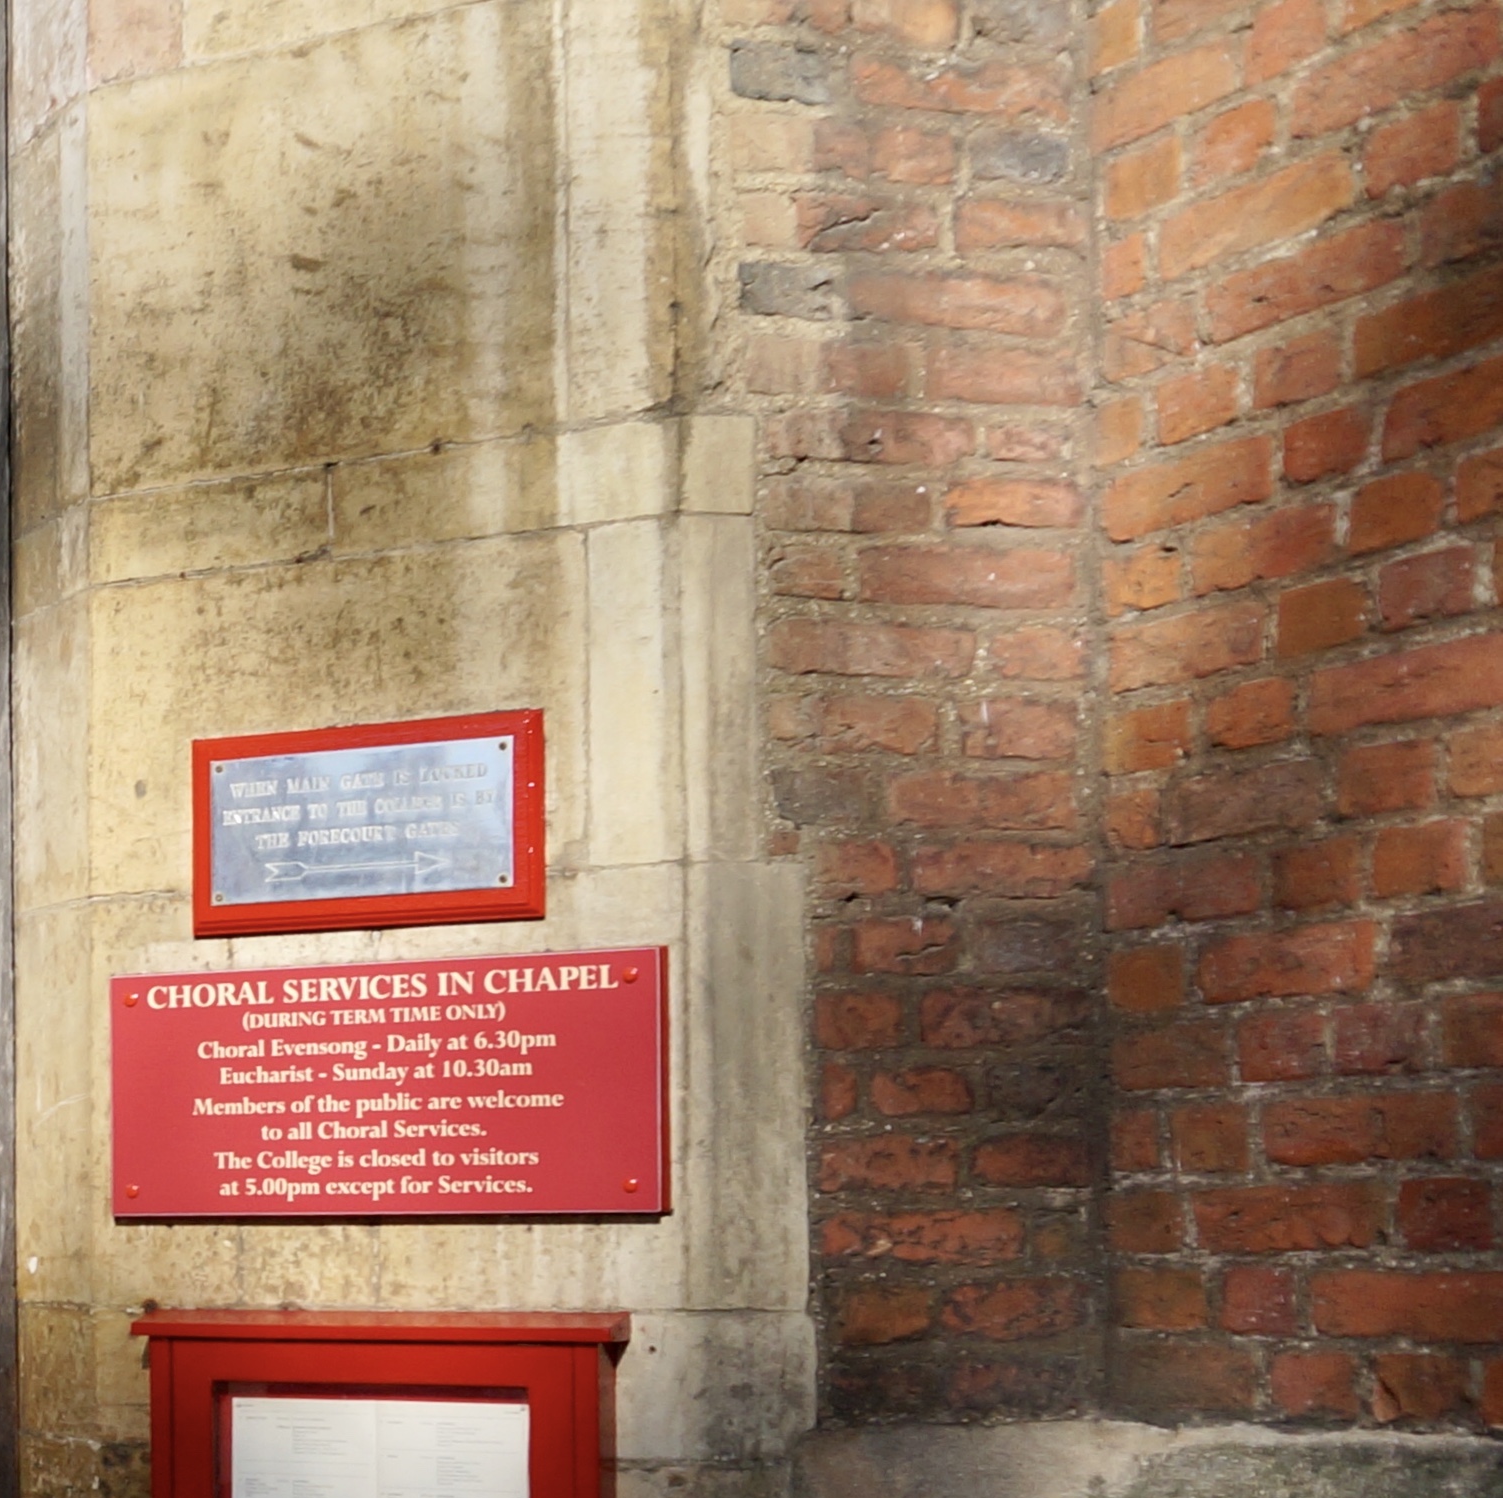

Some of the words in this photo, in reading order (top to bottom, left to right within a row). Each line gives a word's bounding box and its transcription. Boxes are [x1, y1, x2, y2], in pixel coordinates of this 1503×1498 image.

[230, 780, 278, 799] WHEN
[287, 776, 330, 794] MAIN
[340, 772, 384, 789] GATE
[394, 769, 411, 785] IS
[420, 763, 488, 783] LOCKED
[223, 805, 300, 826] ENTRANCE
[308, 803, 328, 819] TO
[337, 800, 366, 817] THE
[374, 794, 442, 815] COLLEGE
[450, 792, 466, 808] IS
[475, 789, 496, 806] BY
[255, 832, 289, 850] THE
[298, 825, 396, 846] FORECOURT
[405, 821, 460, 839] GATES
[147, 981, 274, 1009] CHORAL
[283, 973, 427, 1003] SERVICES
[438, 971, 474, 996] IN
[484, 965, 618, 994] CHAPEL
[242, 1011, 326, 1031] (DURING
[330, 1008, 386, 1025] TERM
[390, 1006, 441, 1022] TIME
[446, 1001, 505, 1021] ONLY)
[198, 1039, 265, 1059] Choral
[271, 1039, 367, 1060] Evensong
[387, 1033, 442, 1057] Daily
[447, 1035, 467, 1050] at
[474, 1031, 556, 1054] 6.30pm
[220, 1065, 313, 1084] Eucharist
[333, 1062, 409, 1086] Sunday
[414, 1063, 434, 1078] at
[443, 1059, 532, 1077] 10.30am
[193, 1097, 286, 1115] Members
[291, 1095, 315, 1113] of
[317, 1094, 350, 1113] the
[356, 1092, 422, 1118] public
[428, 1097, 462, 1109] are
[467, 1090, 563, 1108] welcome
[261, 1126, 282, 1140] to
[287, 1122, 312, 1140] all
[317, 1120, 387, 1139] Choral
[394, 1119, 486, 1137] Services.
[214, 1152, 252, 1169] The
[257, 1150, 332, 1175] College
[338, 1150, 354, 1167] is
[359, 1148, 426, 1167] closed
[432, 1151, 455, 1166] to
[460, 1148, 538, 1165] visitors
[220, 1181, 239, 1195] at
[246, 1178, 320, 1202] 5.00pm
[326, 1179, 394, 1201] except
[401, 1176, 433, 1193] for
[439, 1176, 532, 1193] Services.
